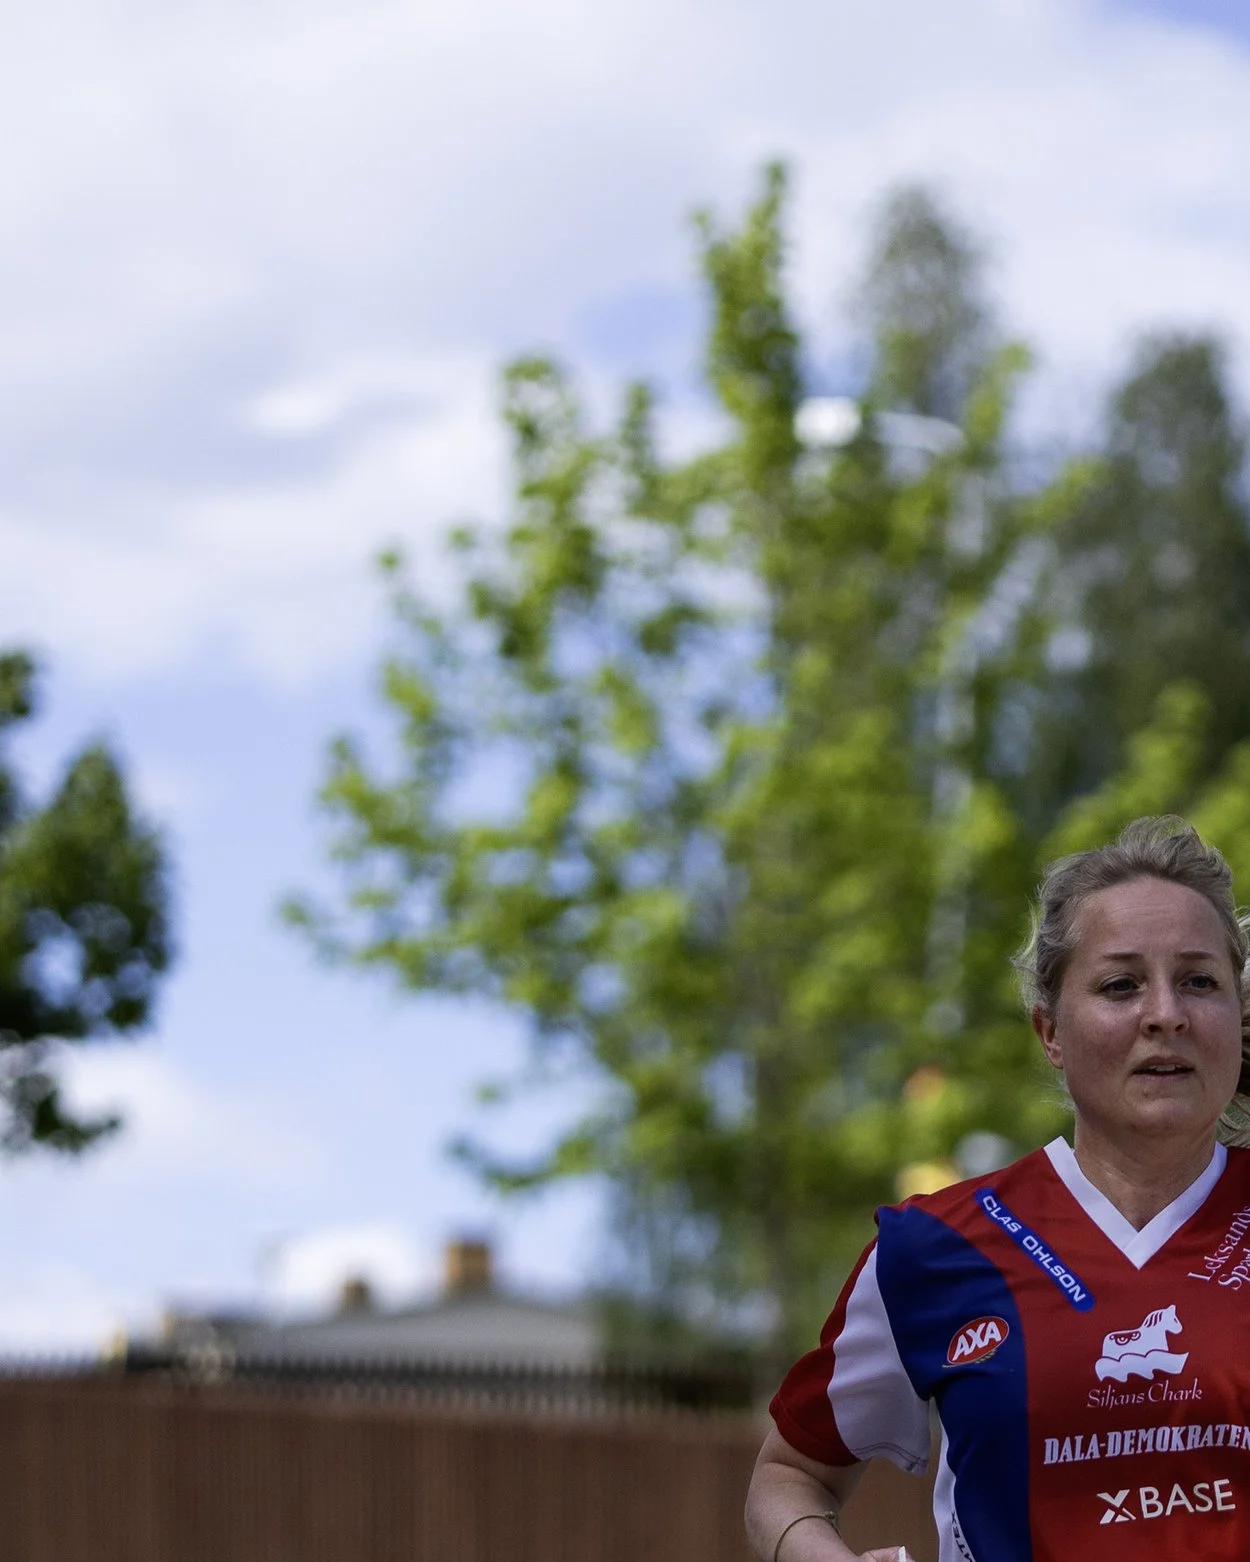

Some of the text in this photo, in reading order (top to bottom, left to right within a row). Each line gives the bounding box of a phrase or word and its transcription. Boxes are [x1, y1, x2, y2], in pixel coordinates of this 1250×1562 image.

[982, 1195, 1086, 1303] CLAS OHLSON
[952, 1321, 1002, 1362] AXA
[1086, 1377, 1203, 1410] Siljans Chark
